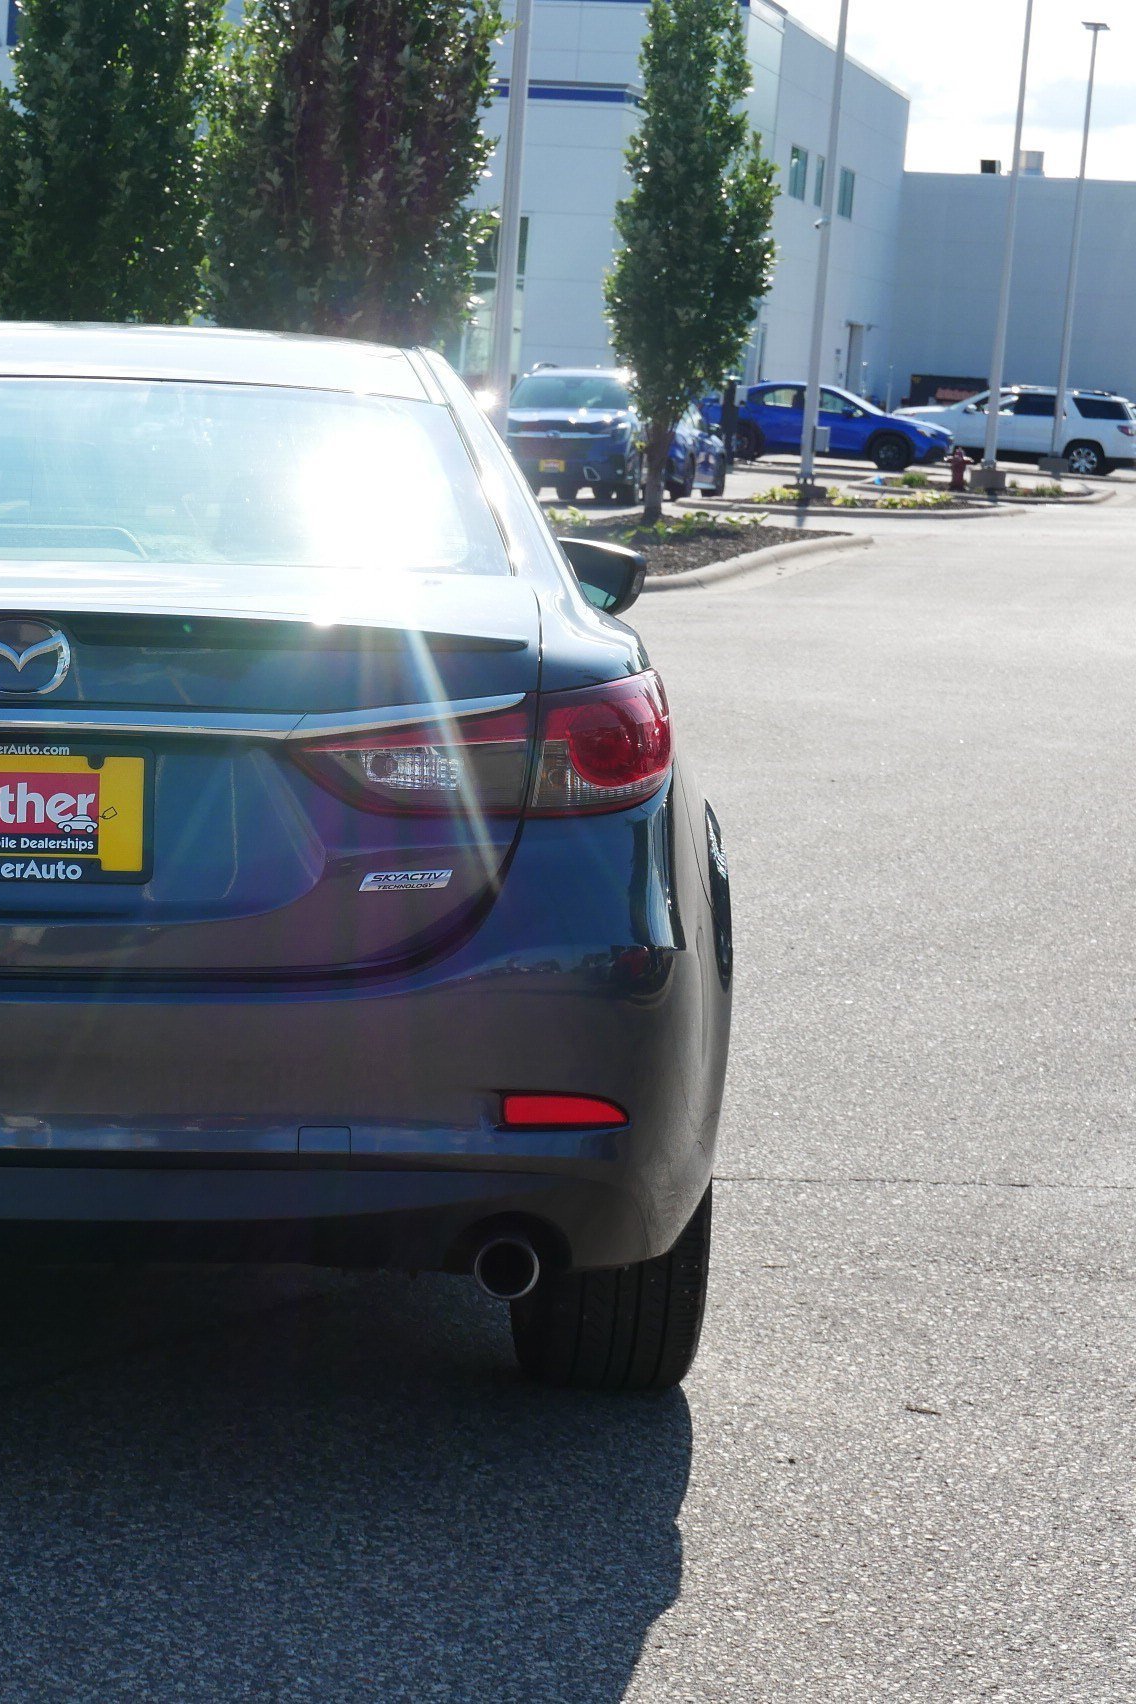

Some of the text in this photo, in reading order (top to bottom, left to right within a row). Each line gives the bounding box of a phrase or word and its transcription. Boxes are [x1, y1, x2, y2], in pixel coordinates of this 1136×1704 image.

[20, 837, 94, 851] Dealerships
[371, 872, 444, 883] SKYACTIV
[377, 882, 435, 890] TECHNOLOGY
